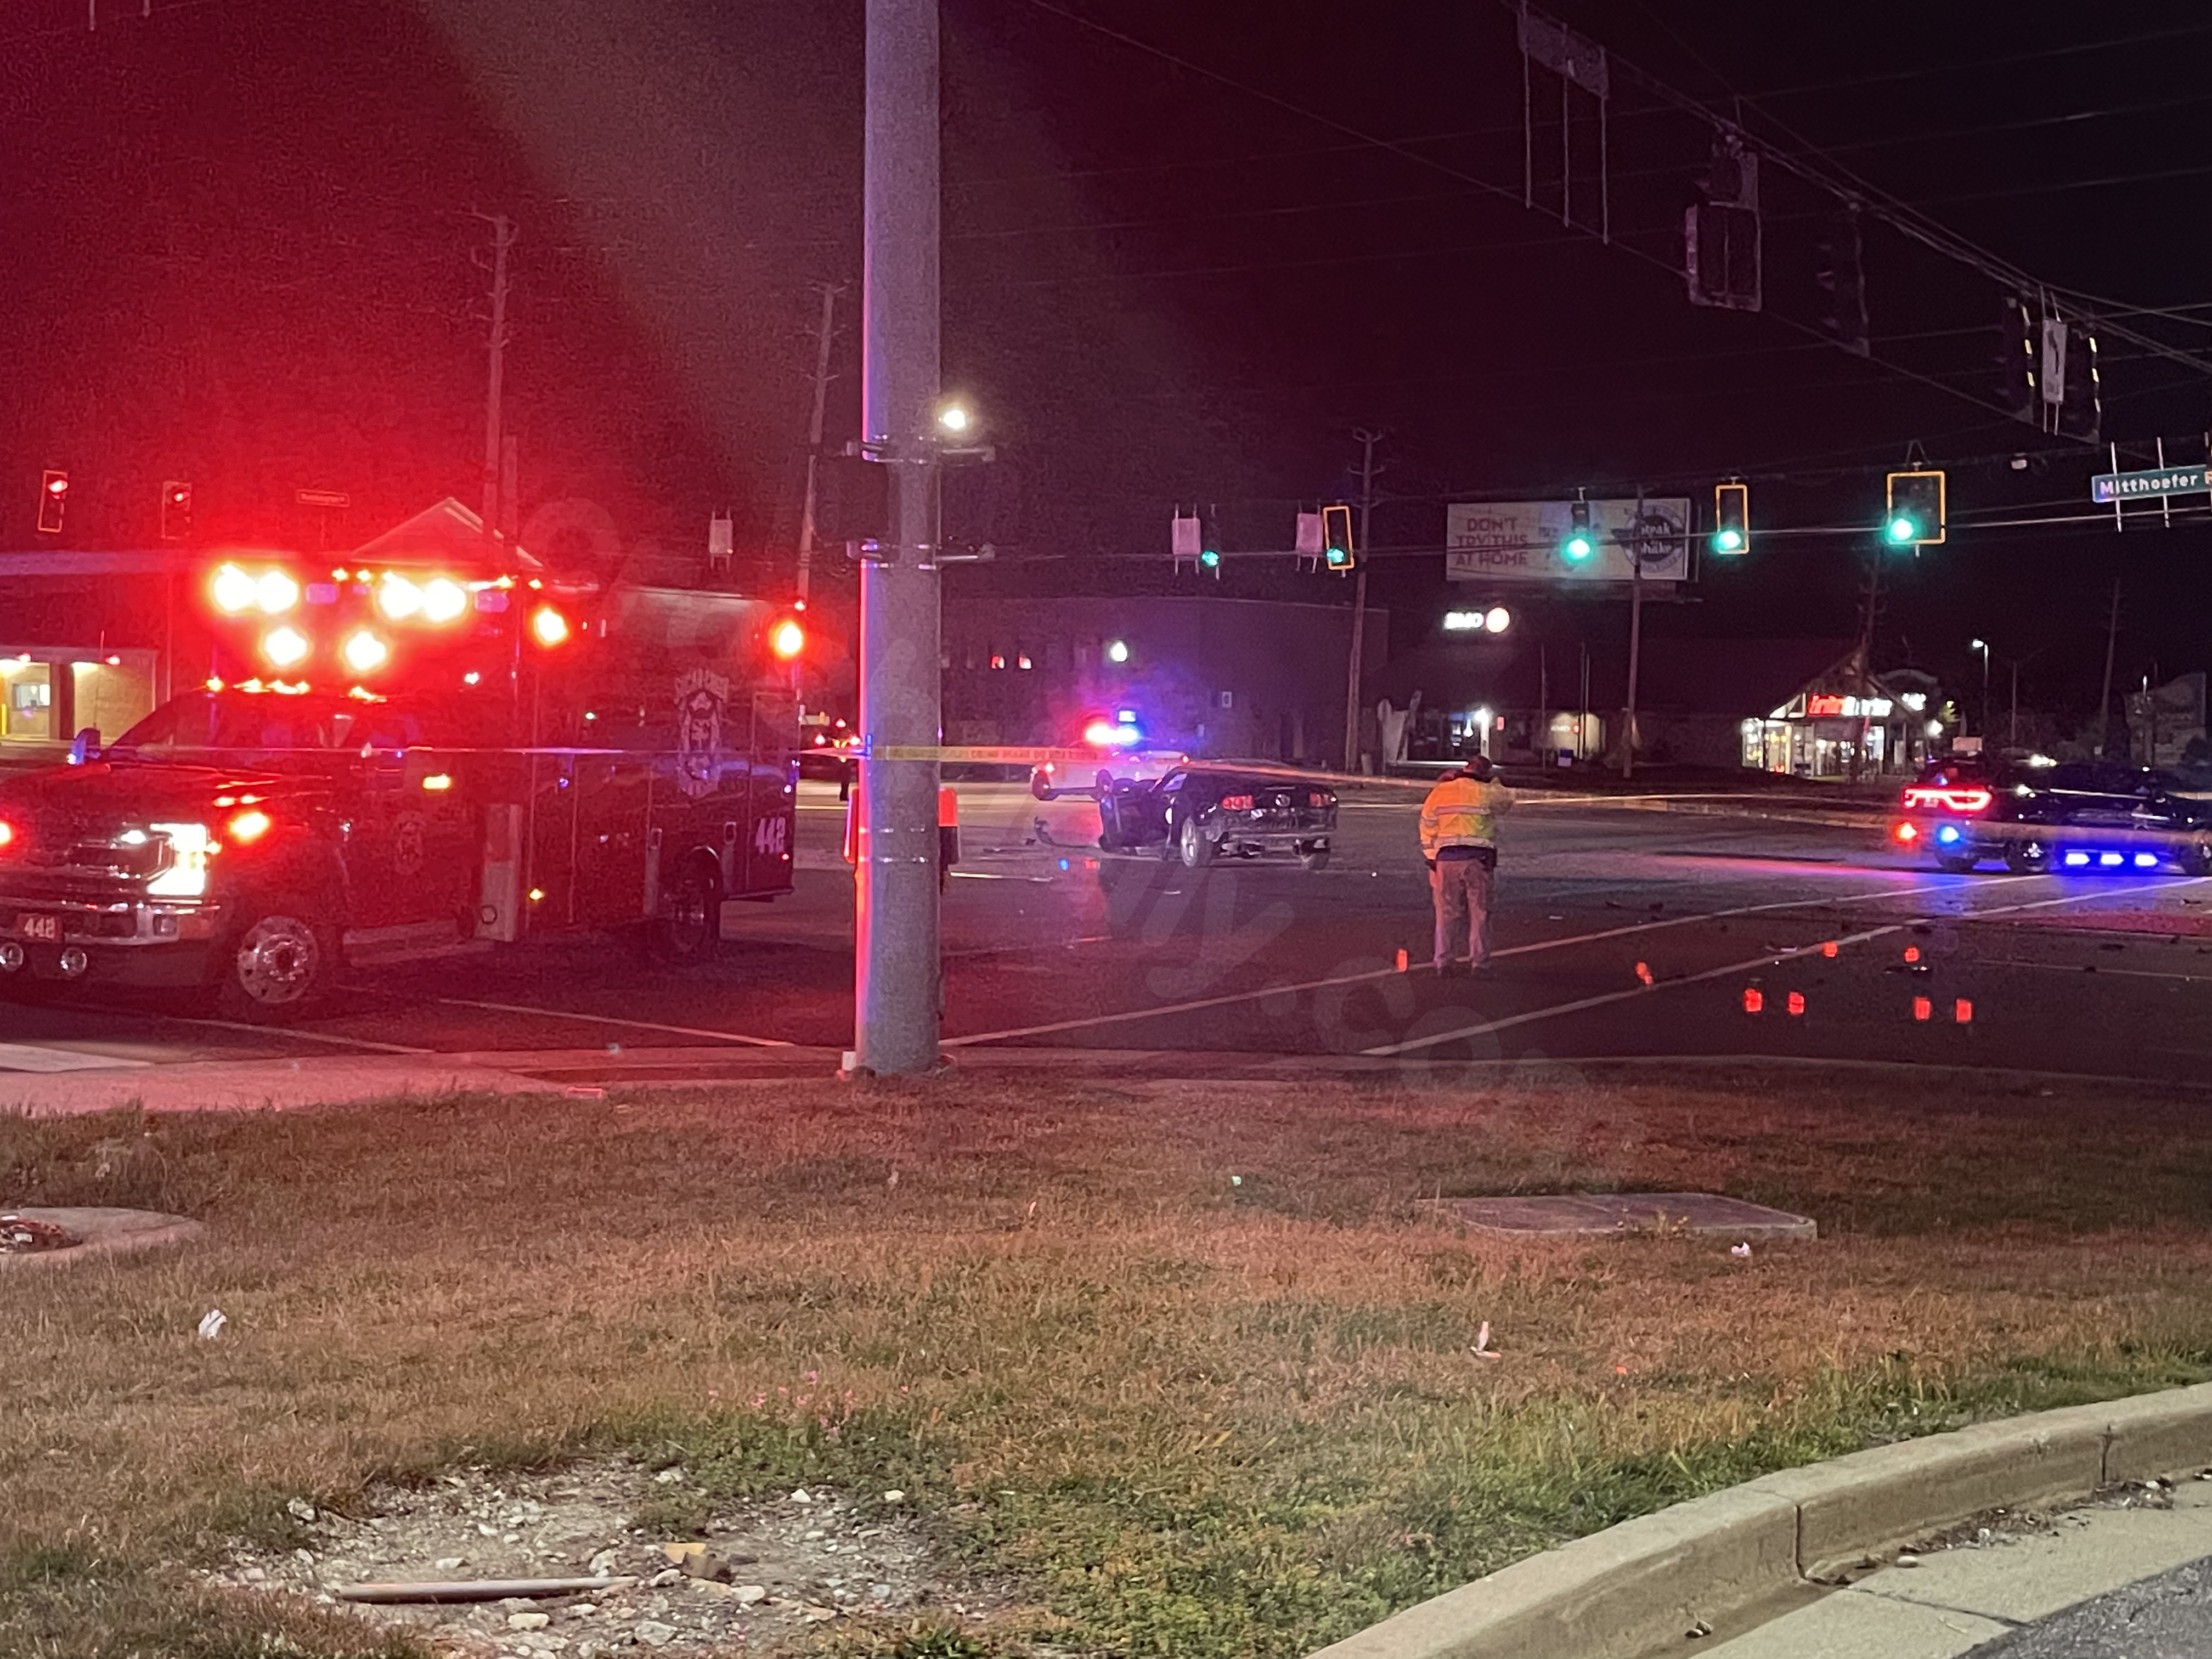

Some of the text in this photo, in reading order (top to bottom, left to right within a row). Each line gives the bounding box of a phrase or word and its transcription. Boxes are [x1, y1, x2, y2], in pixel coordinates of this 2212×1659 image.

[2100, 474, 2198, 495] Mitthoefer
[1467, 517, 1517, 532] DON'T
[1455, 550, 1528, 565] AT HOME
[755, 817, 786, 854] 442
[24, 917, 55, 939] 442
